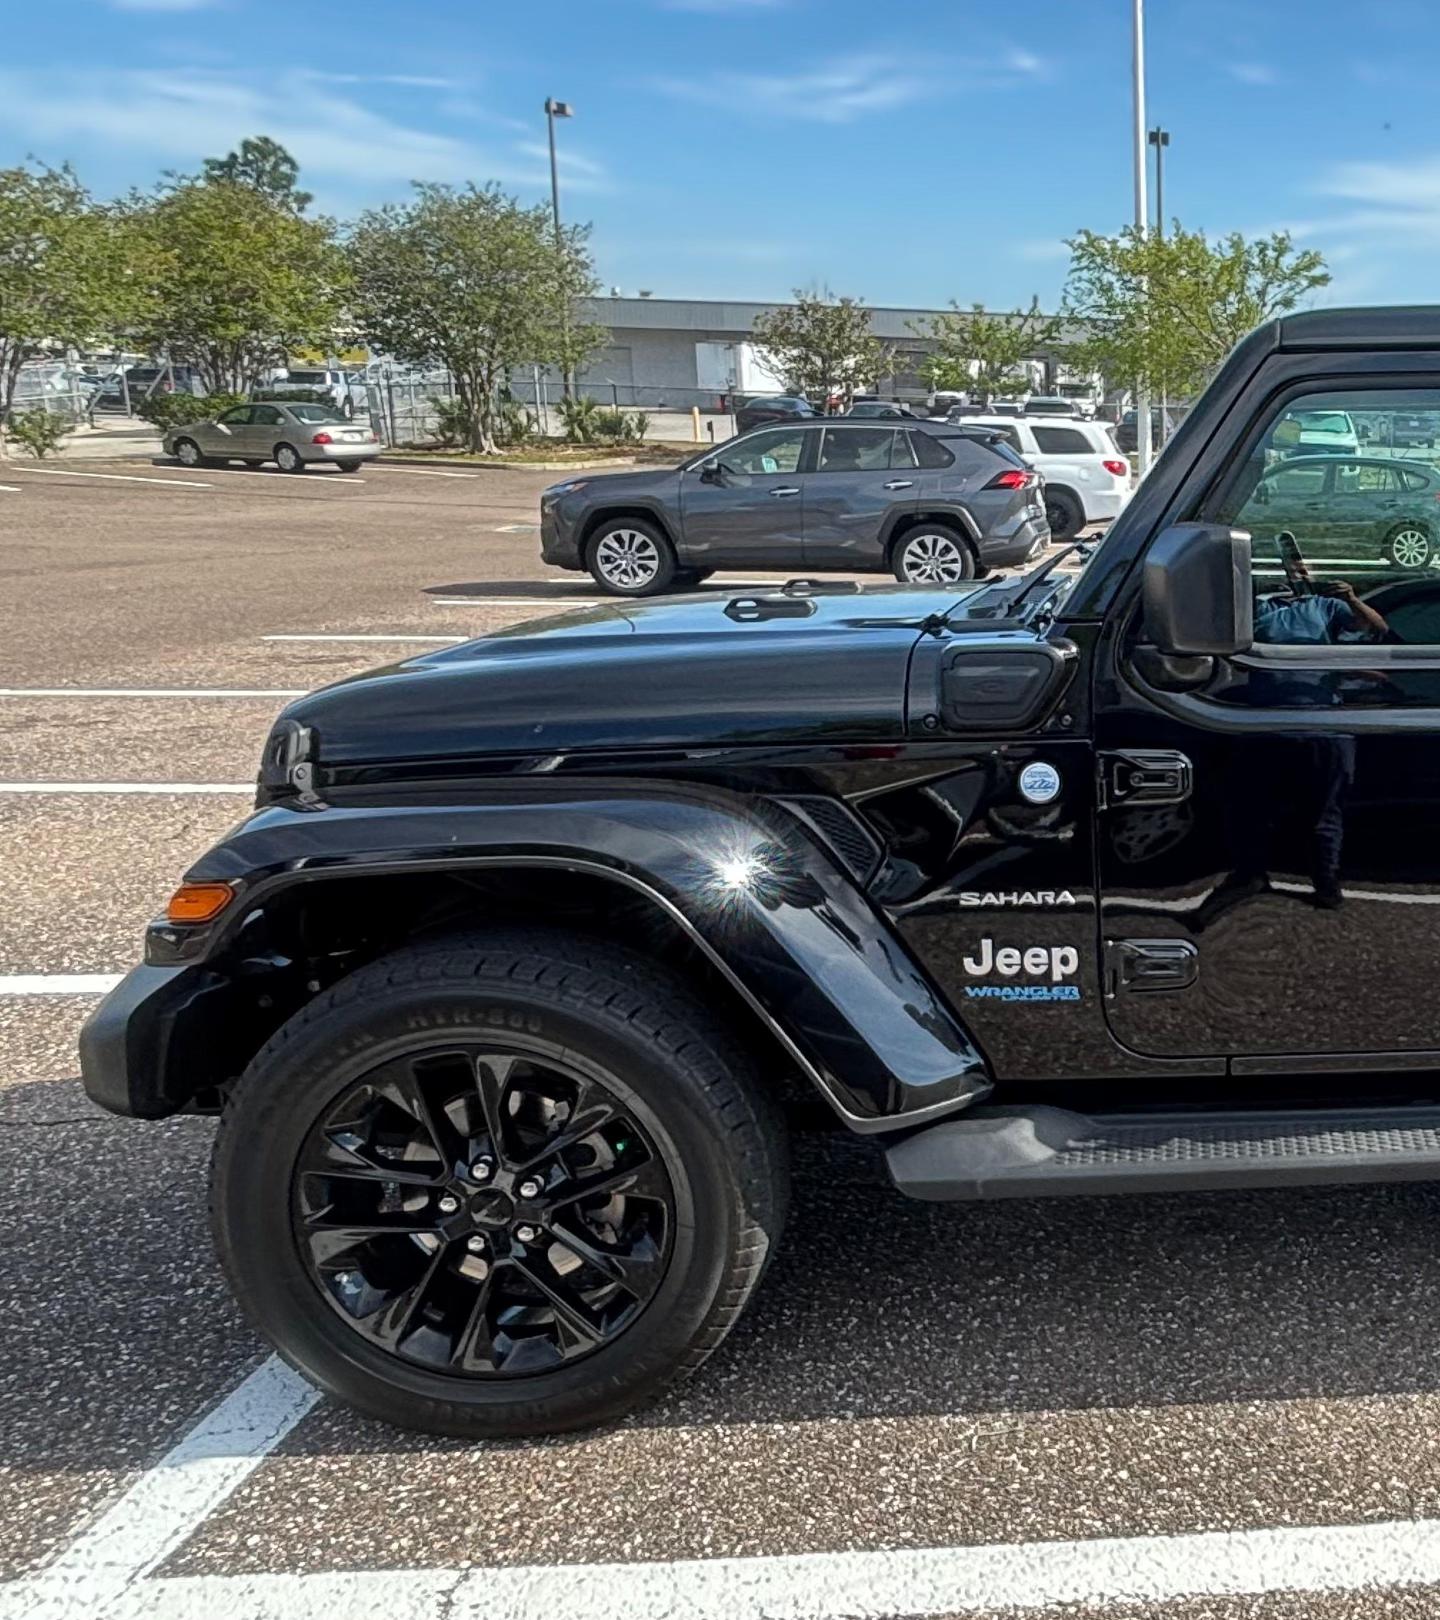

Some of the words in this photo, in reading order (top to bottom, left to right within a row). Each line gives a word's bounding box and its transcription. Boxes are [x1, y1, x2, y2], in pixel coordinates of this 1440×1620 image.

[959, 891, 1076, 906] SAHARA
[963, 939, 1079, 981] Jeep
[964, 986, 1080, 997] WRANGLER
